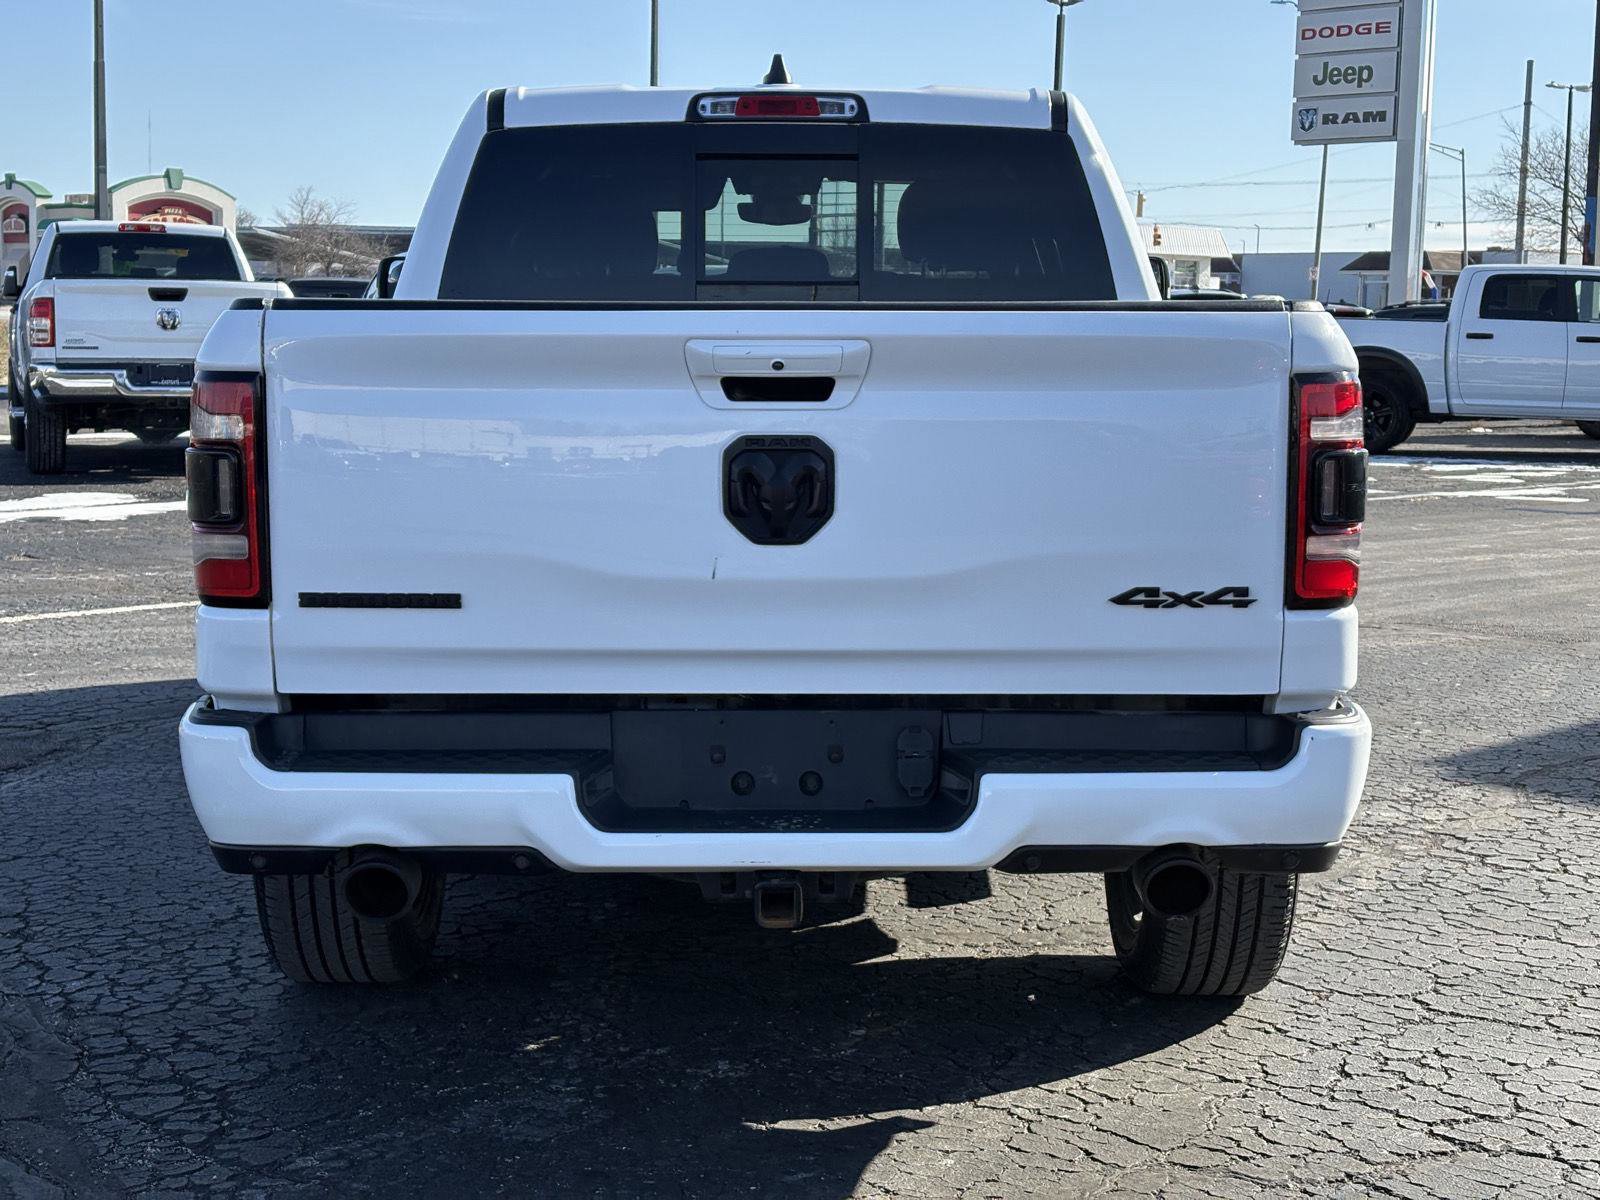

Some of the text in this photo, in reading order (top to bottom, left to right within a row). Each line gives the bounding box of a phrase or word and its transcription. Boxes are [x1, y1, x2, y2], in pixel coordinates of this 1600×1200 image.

[1301, 21, 1391, 40] DODGE
[1312, 61, 1374, 88] Jeep
[1321, 110, 1388, 125] RAM
[1107, 586, 1258, 609] 4x4
